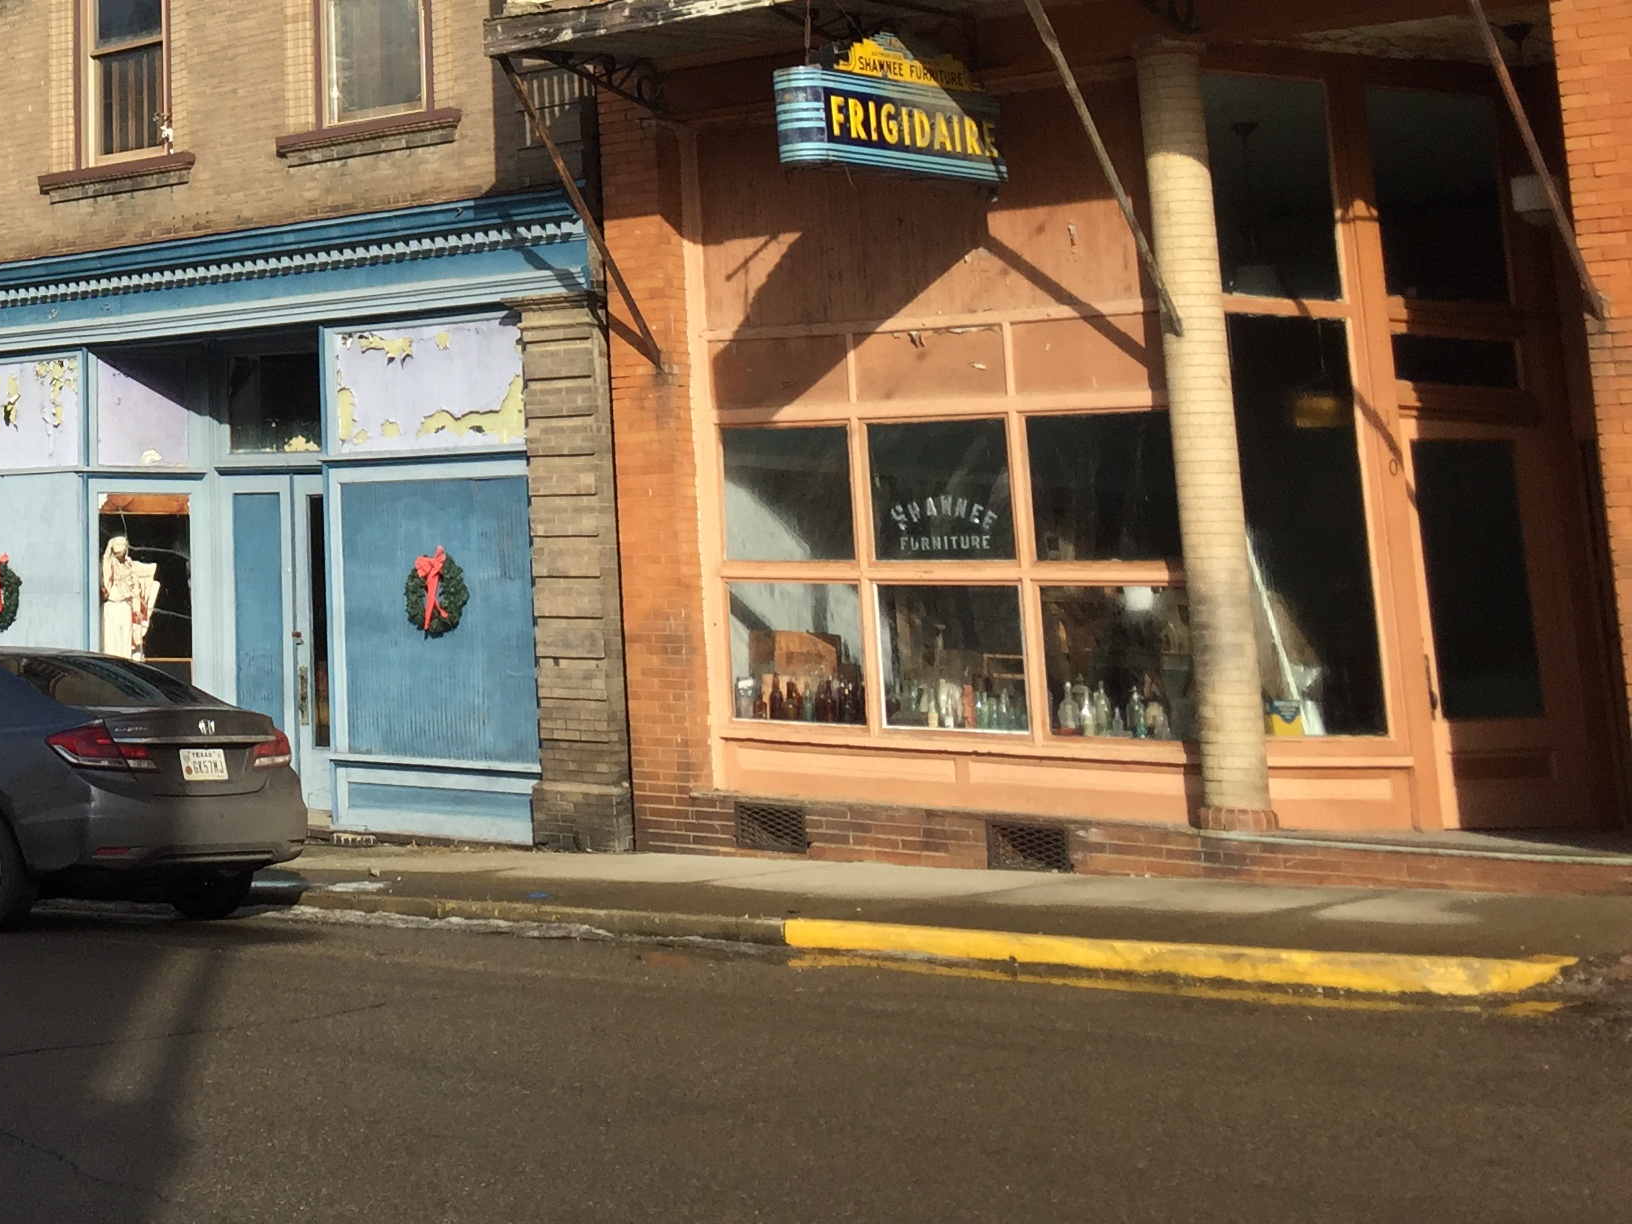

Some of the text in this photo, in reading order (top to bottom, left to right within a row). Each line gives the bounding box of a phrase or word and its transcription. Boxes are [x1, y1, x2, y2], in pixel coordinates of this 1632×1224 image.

[857, 55, 904, 78] SHAWNEE
[909, 64, 964, 88] FURNITURE
[829, 94, 1000, 159] FRIGIDAIRE
[890, 494, 998, 531] SHAWNEE
[900, 535, 991, 551] FURNITURE
